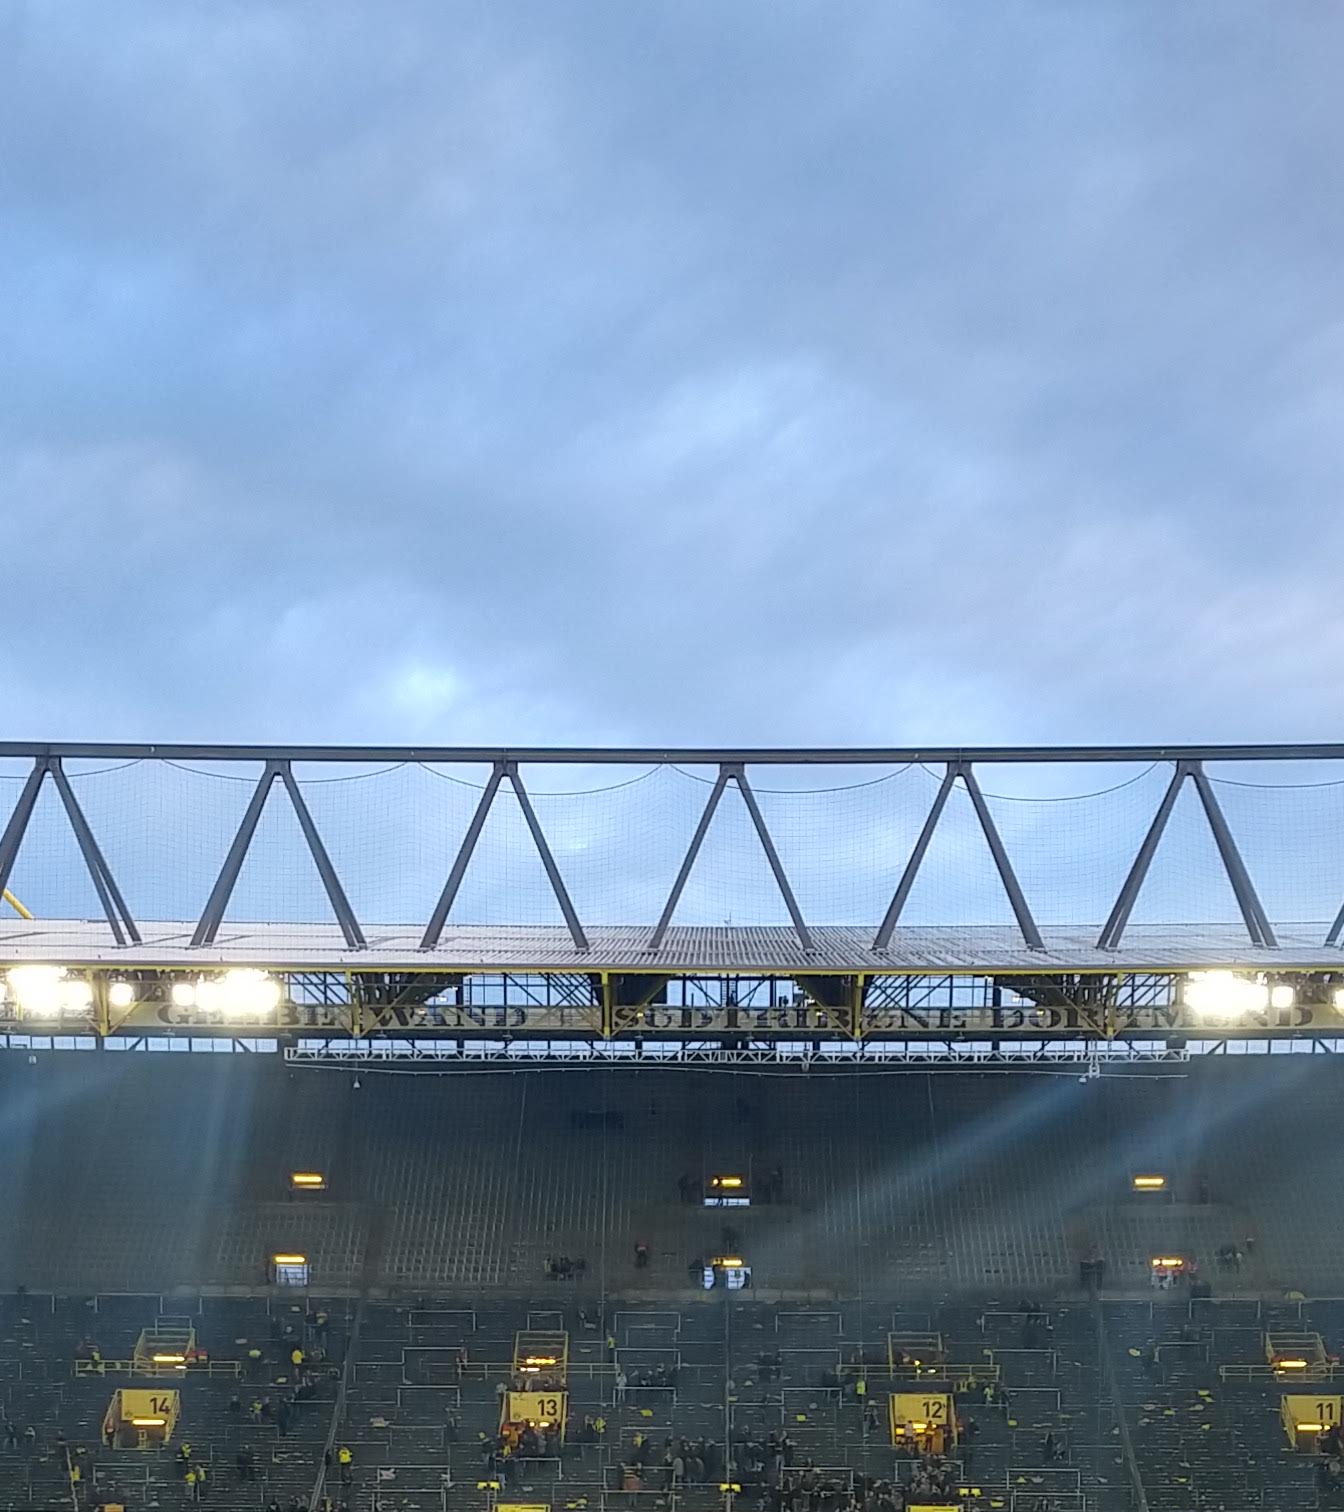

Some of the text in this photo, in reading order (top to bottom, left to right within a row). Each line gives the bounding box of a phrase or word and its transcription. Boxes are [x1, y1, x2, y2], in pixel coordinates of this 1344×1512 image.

[369, 1007, 527, 1027] WAND
[150, 1397, 170, 1414] 14
[537, 1399, 558, 1416] 13
[922, 1401, 942, 1419] 12
[1316, 1403, 1333, 1420] 11
